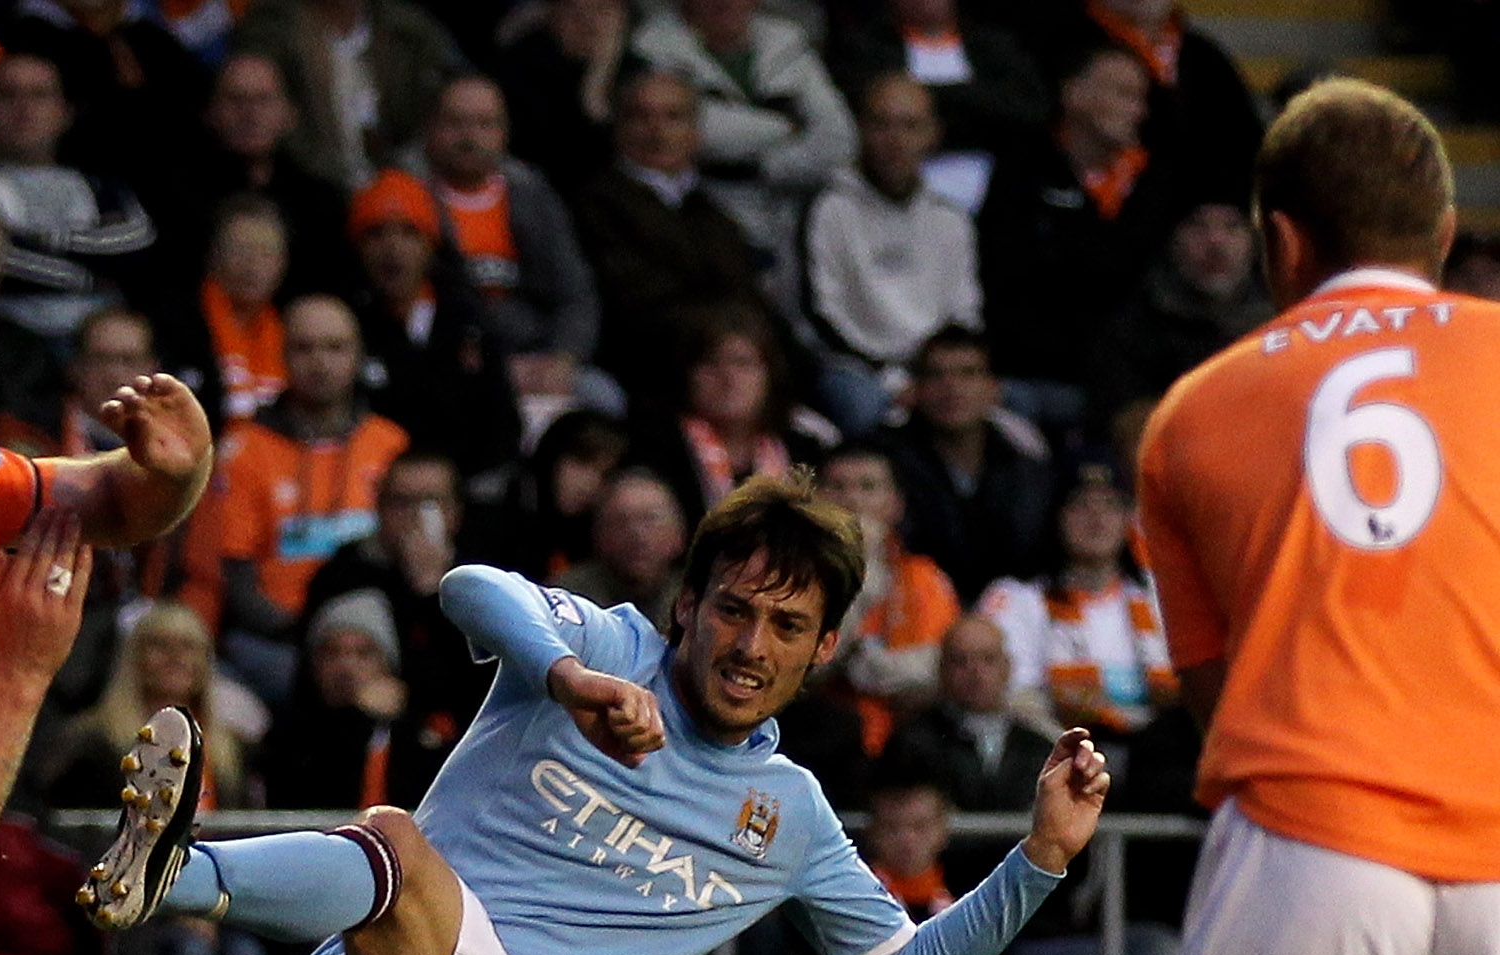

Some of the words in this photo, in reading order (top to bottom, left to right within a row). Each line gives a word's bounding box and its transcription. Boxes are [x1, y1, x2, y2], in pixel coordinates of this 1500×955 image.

[1263, 302, 1453, 354] EVATT
[1304, 346, 1442, 550] 6
[531, 760, 743, 908] ETIHAD
